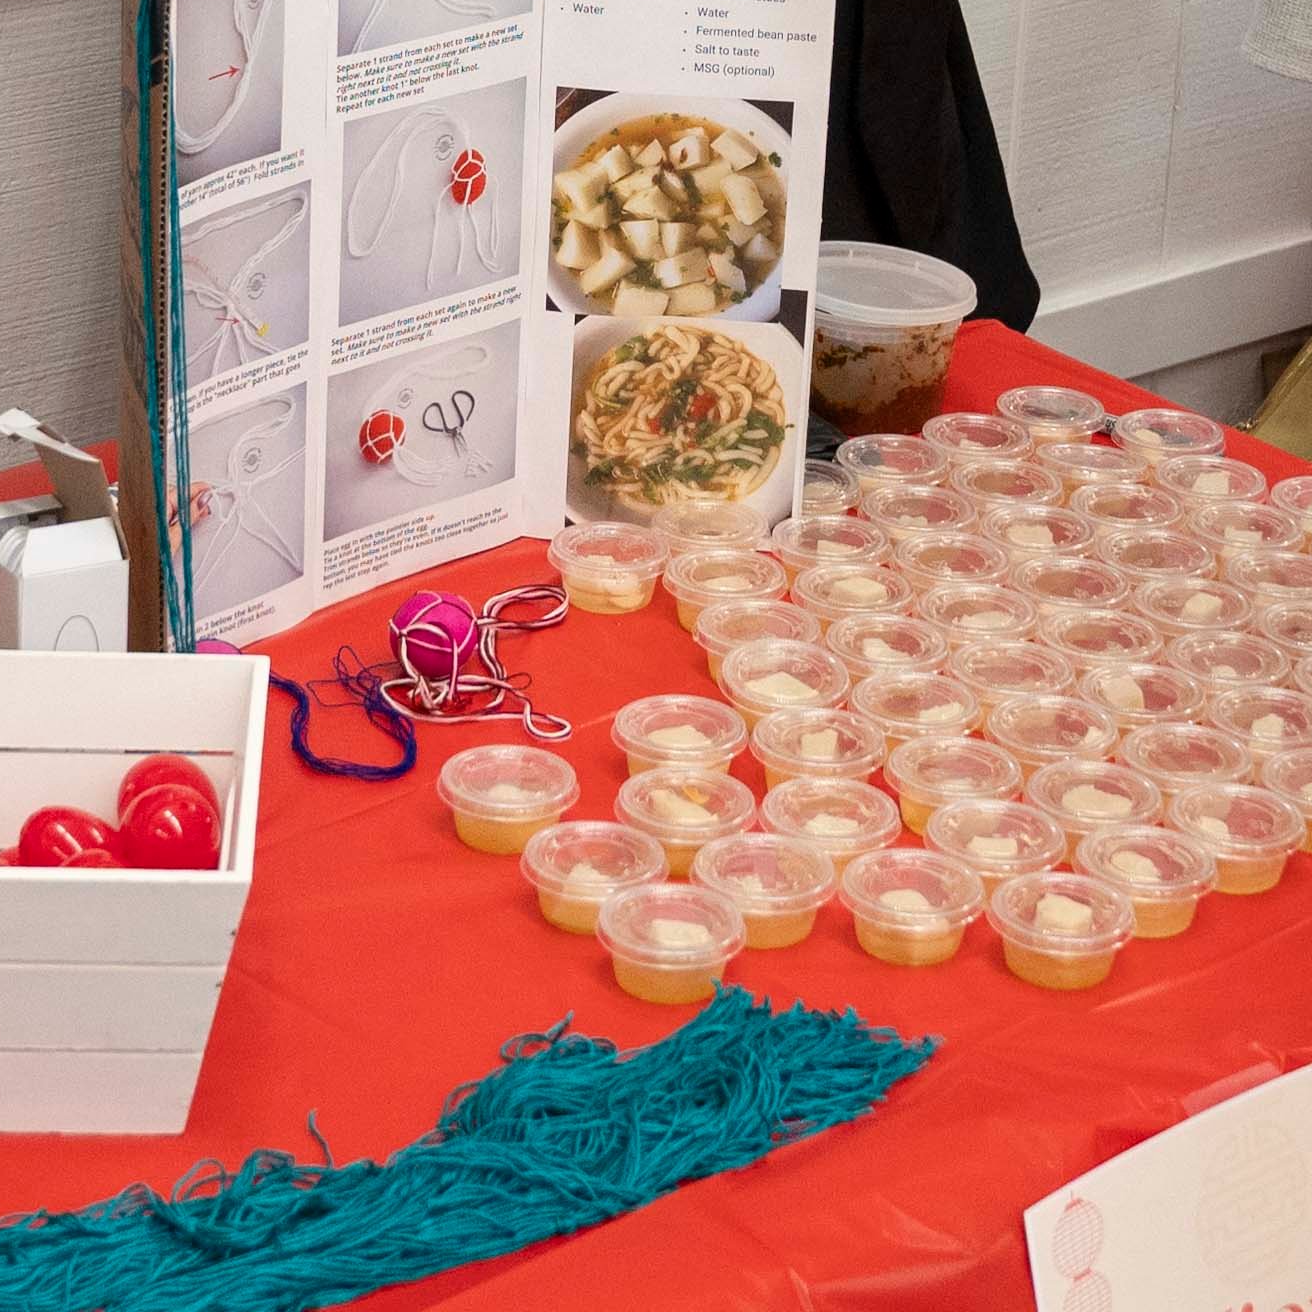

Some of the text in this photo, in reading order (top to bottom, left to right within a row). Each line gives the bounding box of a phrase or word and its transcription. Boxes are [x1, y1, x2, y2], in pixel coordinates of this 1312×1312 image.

[573, 4, 604, 15] Water
[698, 8, 729, 18] Water
[696, 26, 816, 42] Fermented bean paste
[336, 60, 371, 72] Separate
[379, 50, 403, 62] strand
[405, 48, 422, 56] from
[424, 41, 441, 52] each
[443, 39, 454, 47] set
[465, 32, 484, 42] make
[492, 28, 506, 36] new
[507, 24, 517, 32] set
[695, 44, 760, 57] Salt to taste
[694, 63, 775, 78] MSG (optional)
[337, 94, 348, 102] Tie
[349, 87, 380, 99] another
[382, 82, 399, 92] knot
[410, 75, 431, 85] below
[432, 71, 445, 79] the
[446, 67, 459, 76] last
[461, 63, 479, 72] knot.
[336, 101, 362, 113] Repeat
[377, 92, 394, 103] each
[396, 91, 411, 99] new
